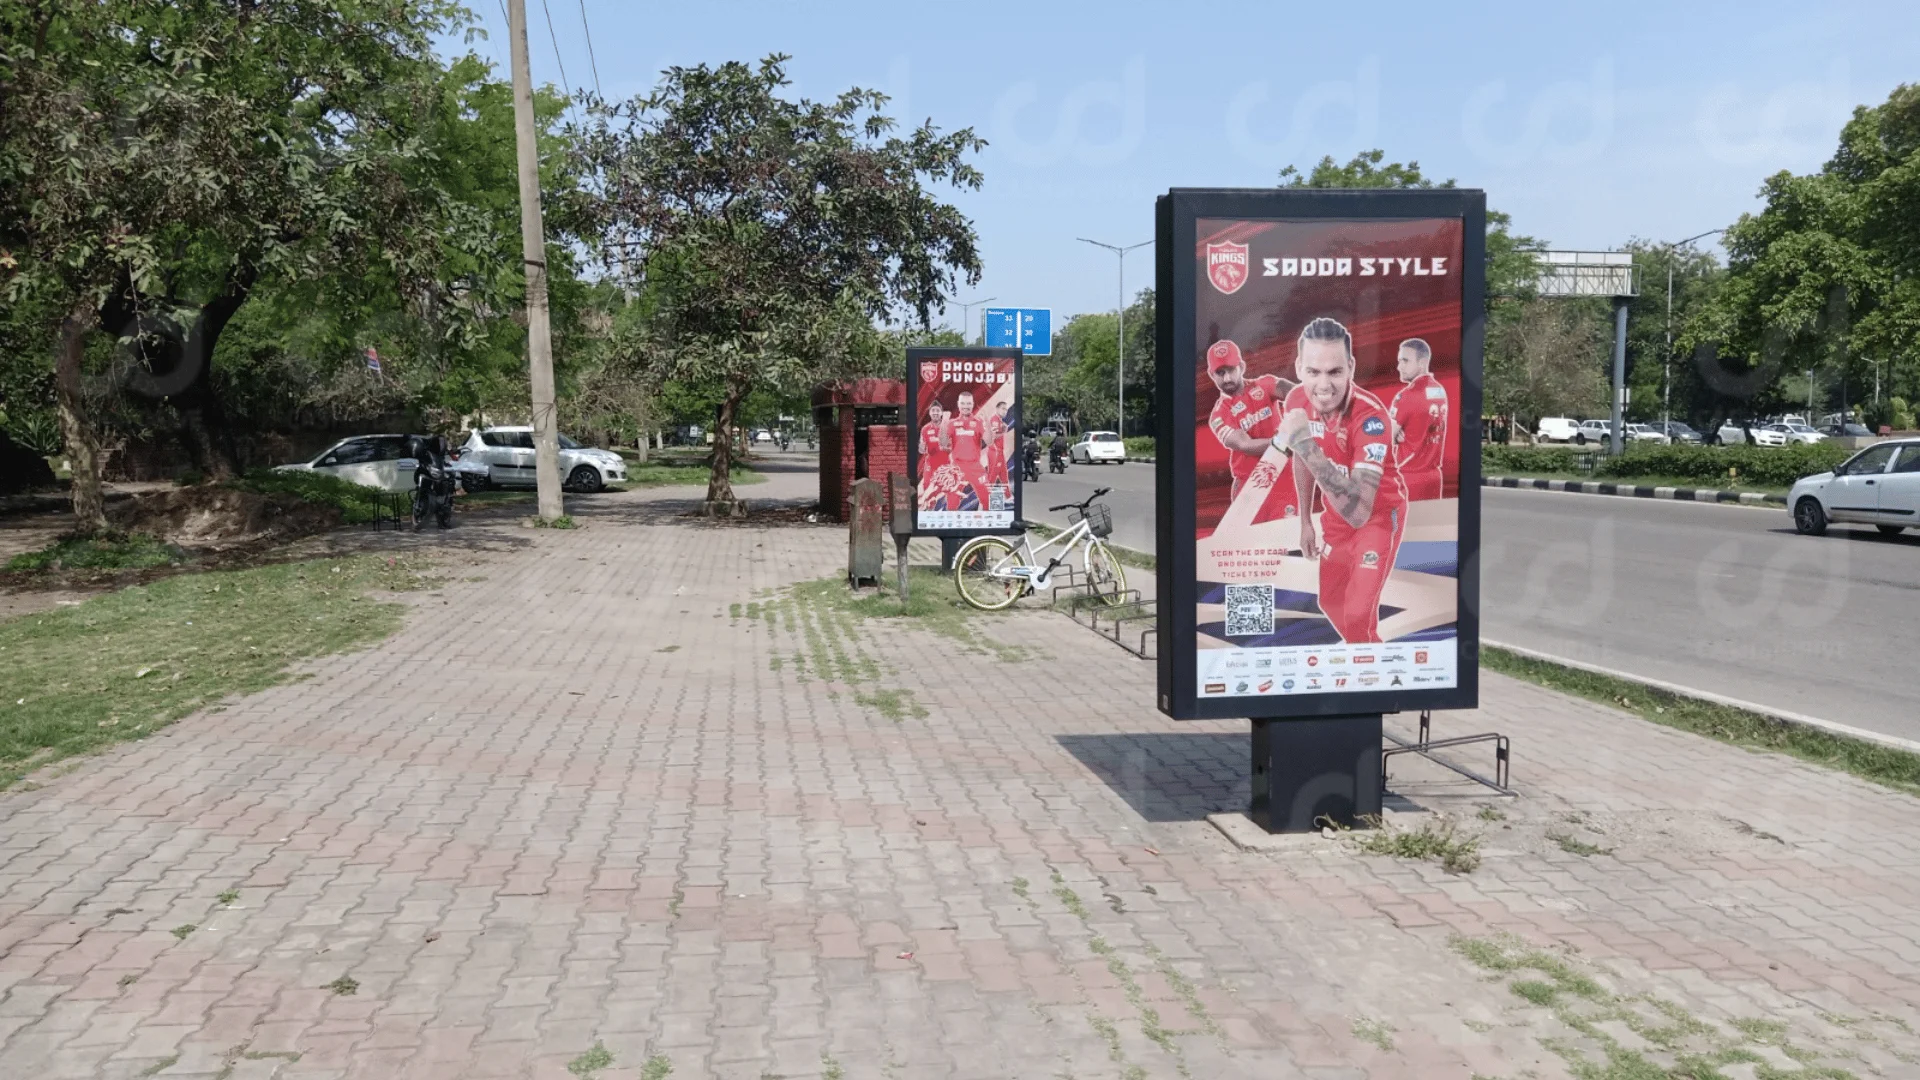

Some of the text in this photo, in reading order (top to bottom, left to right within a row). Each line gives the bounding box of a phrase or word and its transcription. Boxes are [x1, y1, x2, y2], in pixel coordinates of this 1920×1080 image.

[1211, 252, 1245, 265] KINGS
[1262, 257, 1448, 277] SADDA STYLE
[942, 361, 994, 372] DHOOM
[1211, 549, 1233, 558] SCAN
[1236, 549, 1252, 557] THE
[1218, 560, 1235, 568] AND
[1260, 559, 1282, 567] YOUR
